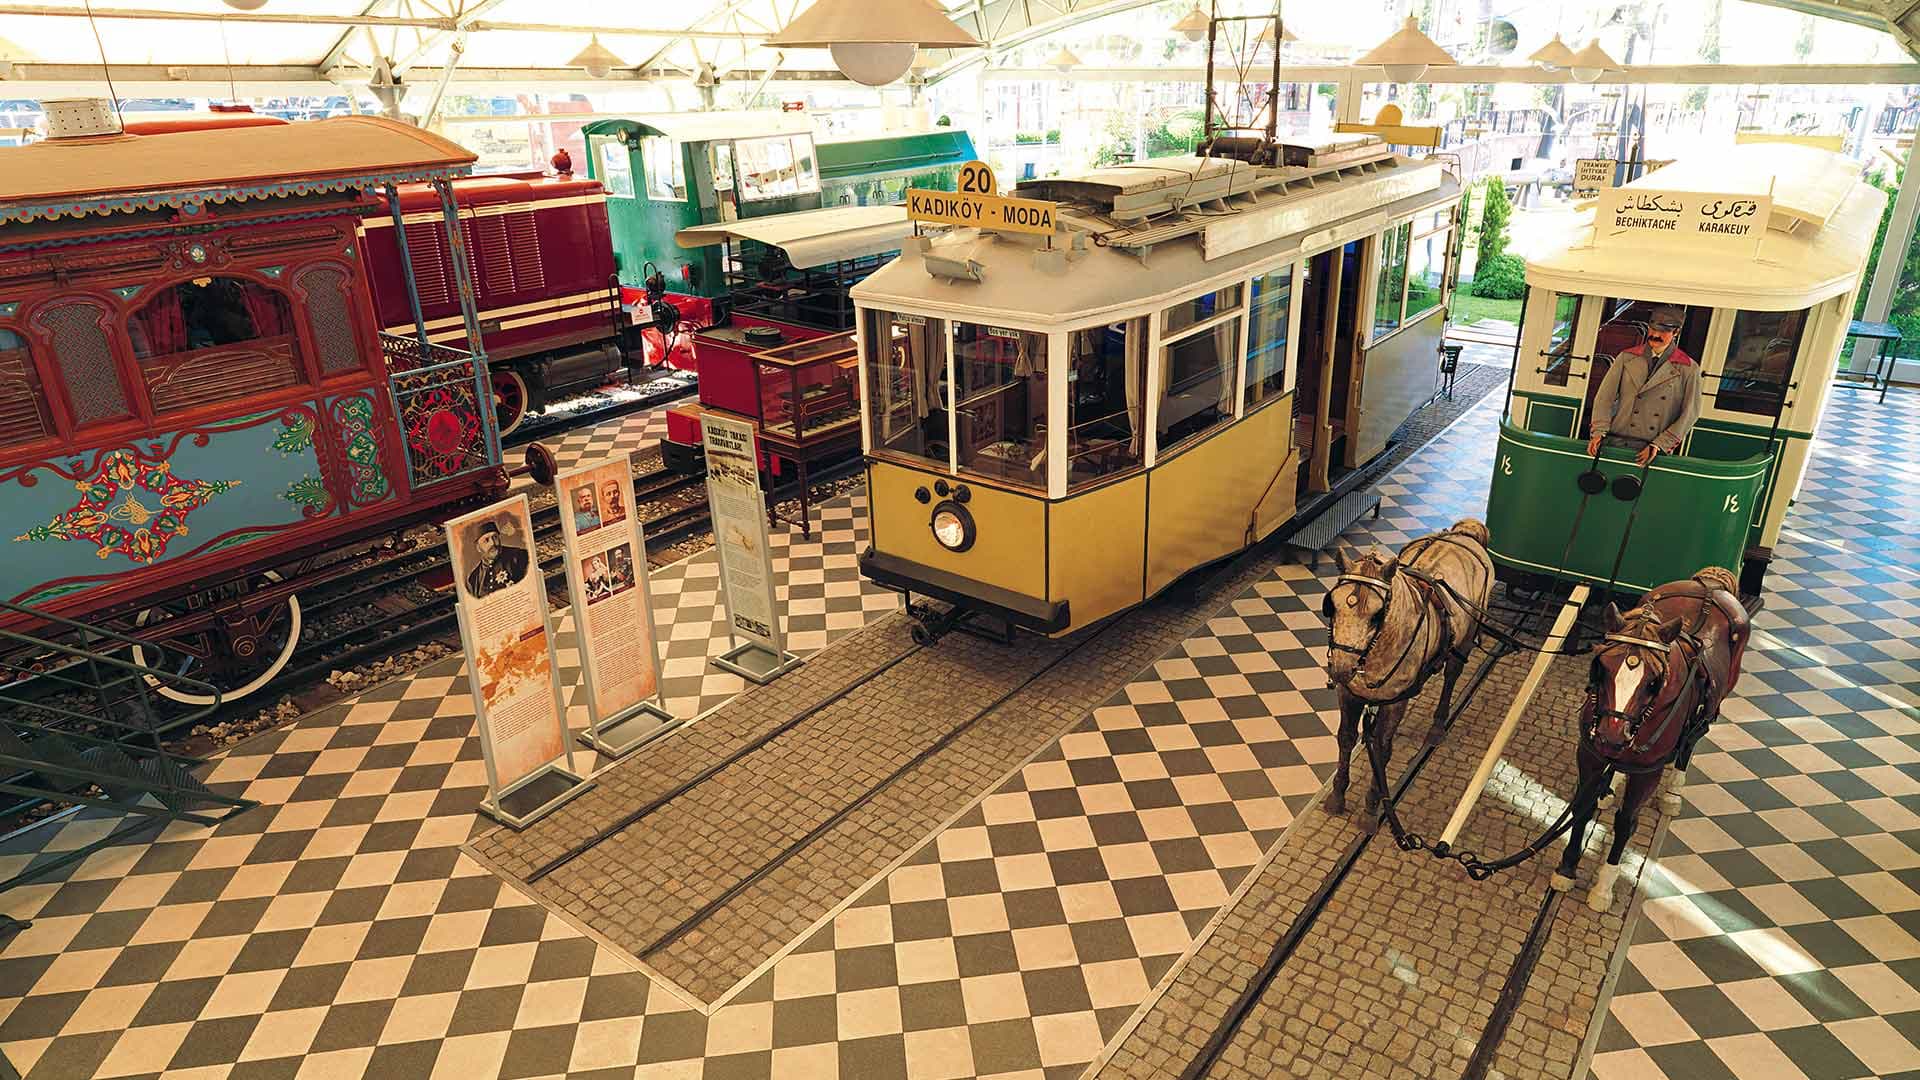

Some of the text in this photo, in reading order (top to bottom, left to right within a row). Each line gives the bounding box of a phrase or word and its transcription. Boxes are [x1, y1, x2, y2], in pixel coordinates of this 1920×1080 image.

[963, 167, 991, 194] 20
[911, 196, 983, 220] KADIKÖY
[1003, 205, 1051, 228] MODA
[1699, 222, 1750, 235] KARAKEUY
